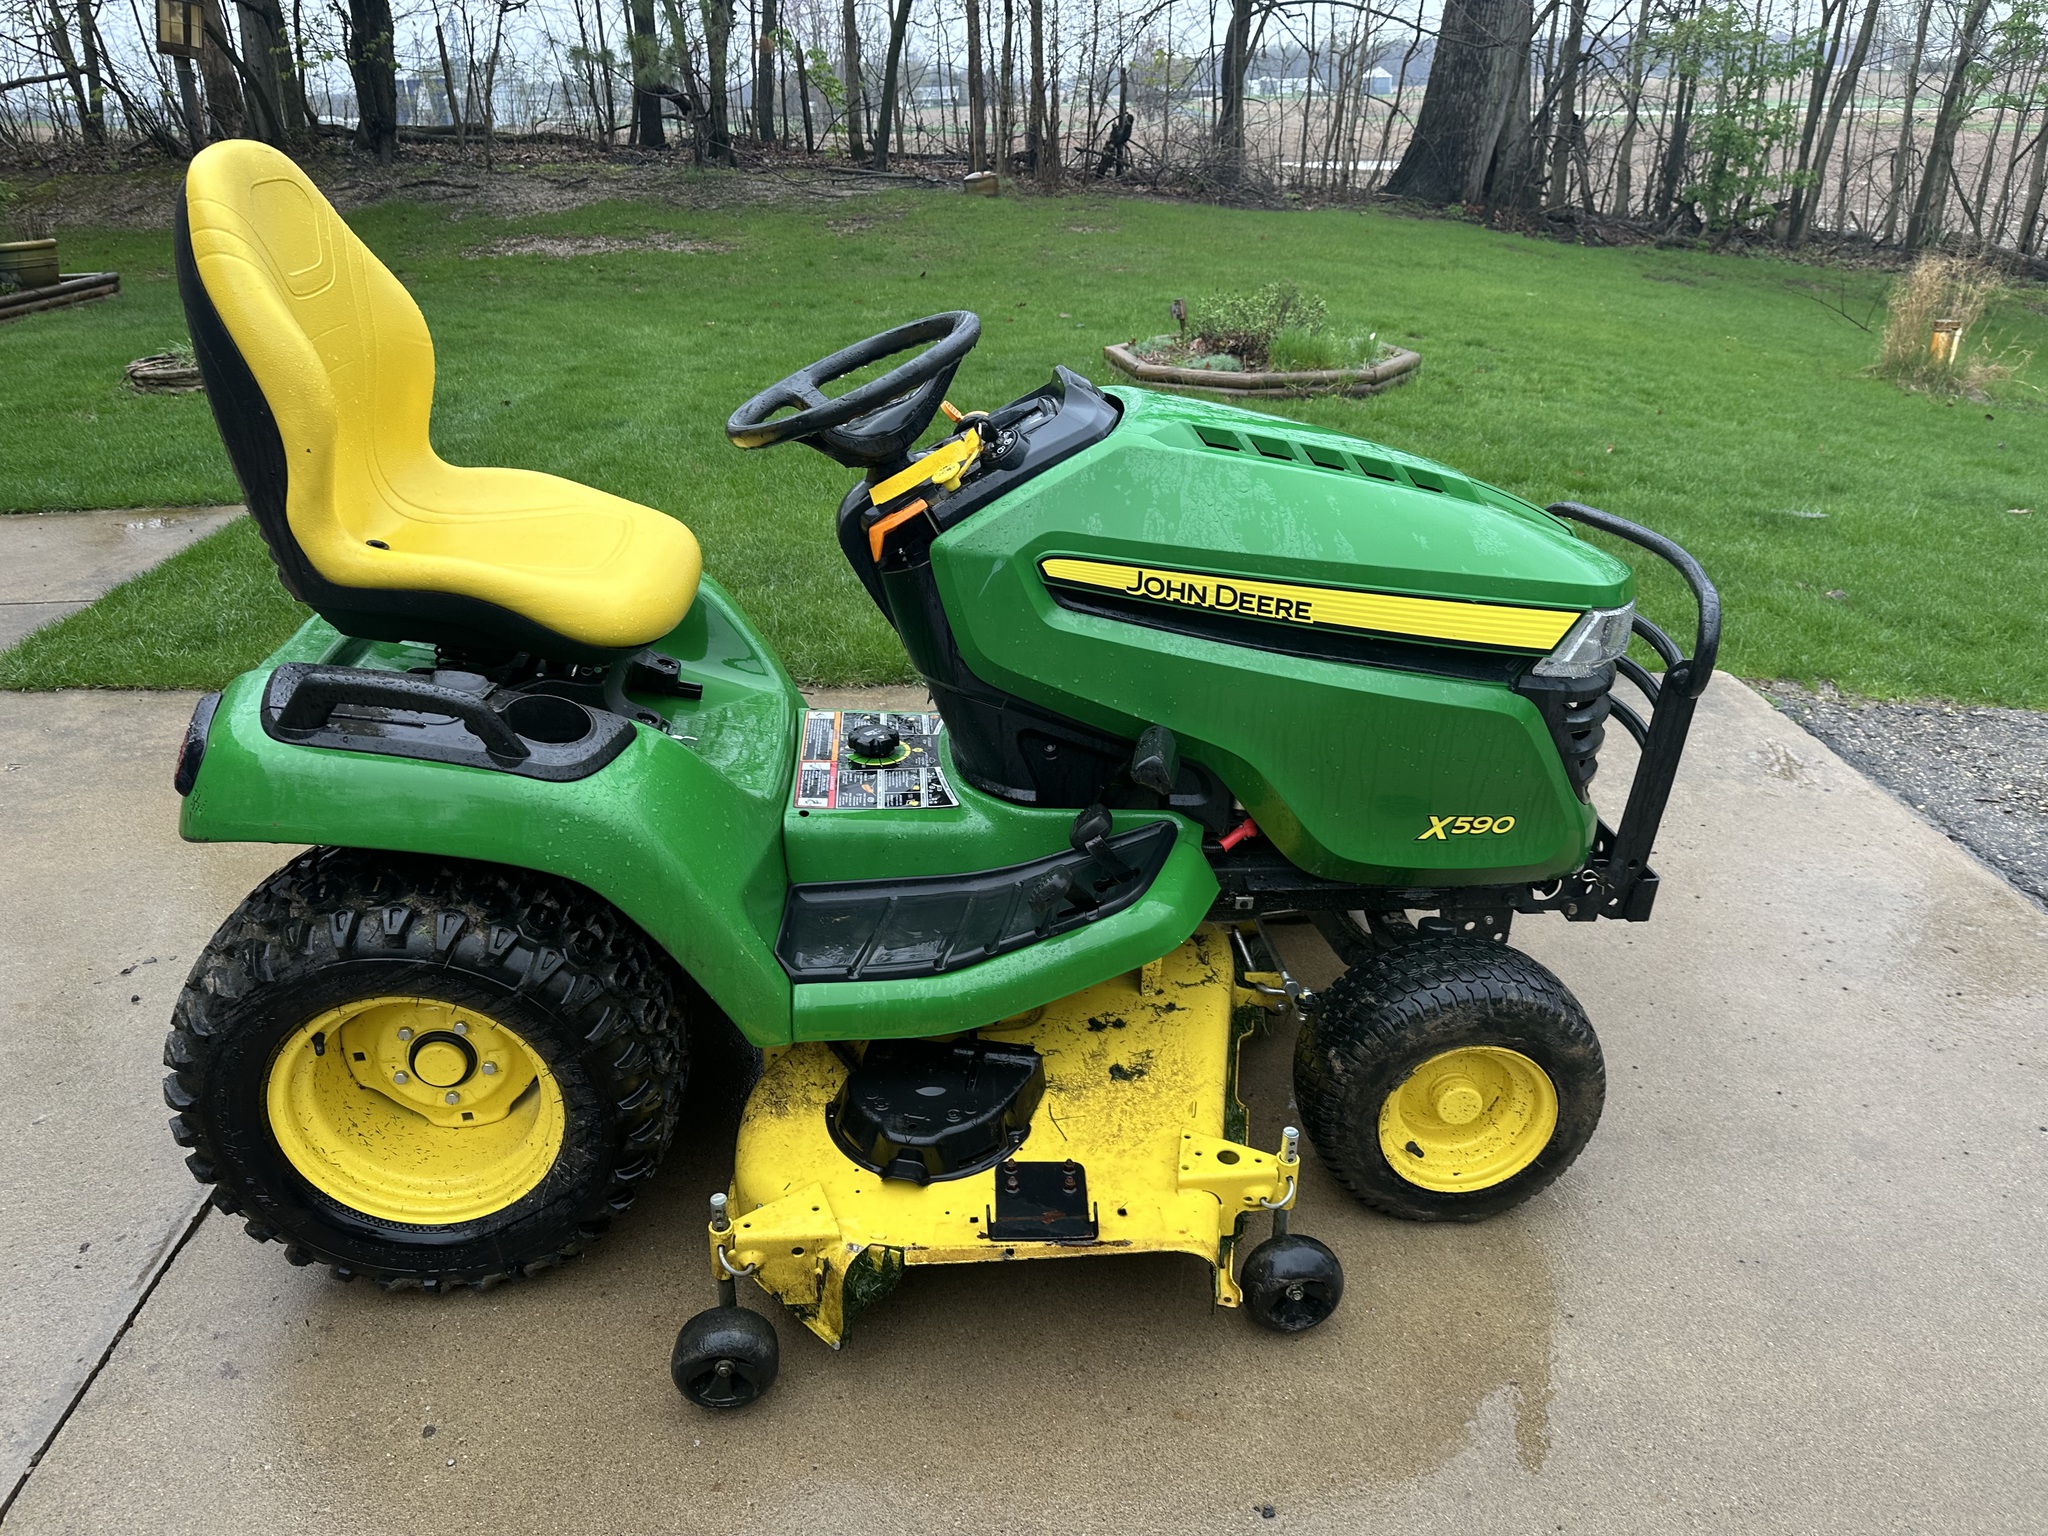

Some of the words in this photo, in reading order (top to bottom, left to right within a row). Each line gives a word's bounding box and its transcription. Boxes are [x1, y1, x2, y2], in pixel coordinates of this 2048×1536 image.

[1126, 571, 1208, 604] JOHN
[1215, 584, 1313, 621] DEERE
[1414, 815, 1516, 841] X590
